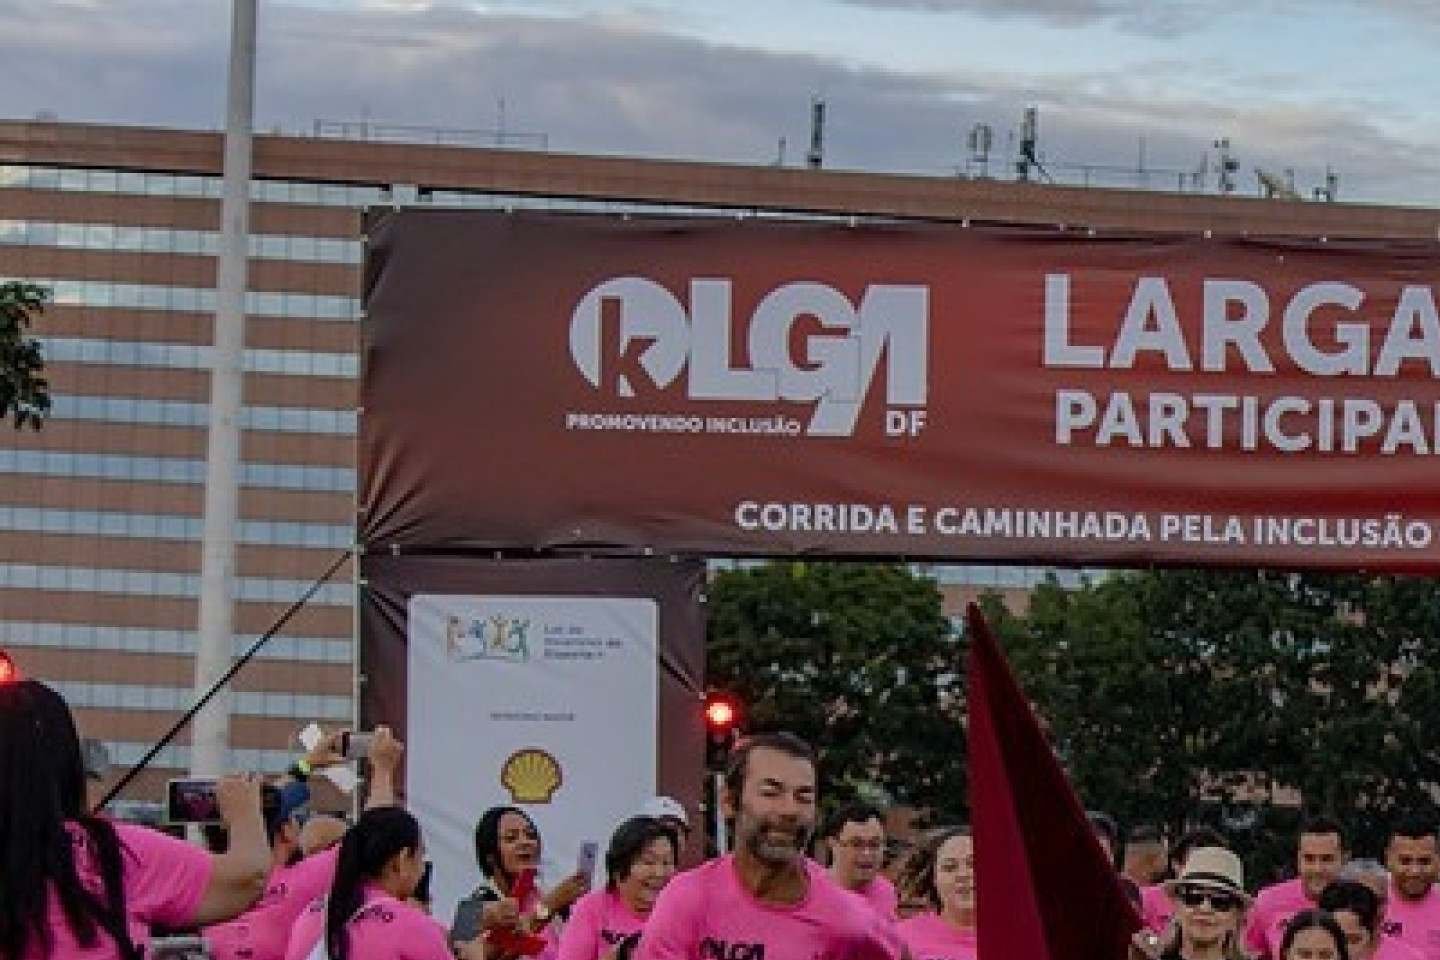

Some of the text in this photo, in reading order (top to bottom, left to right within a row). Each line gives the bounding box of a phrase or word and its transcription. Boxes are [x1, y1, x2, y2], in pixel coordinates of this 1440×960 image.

[565, 413, 801, 436] PROMOVENDO INCLUSÃO
[886, 410, 927, 437] DF
[735, 501, 896, 534] CORRIDA
[907, 507, 924, 534] E
[934, 507, 1151, 541] CAMINHADA
[1160, 514, 1244, 545] PELA
[1254, 514, 1429, 549] INCLUSÃO
